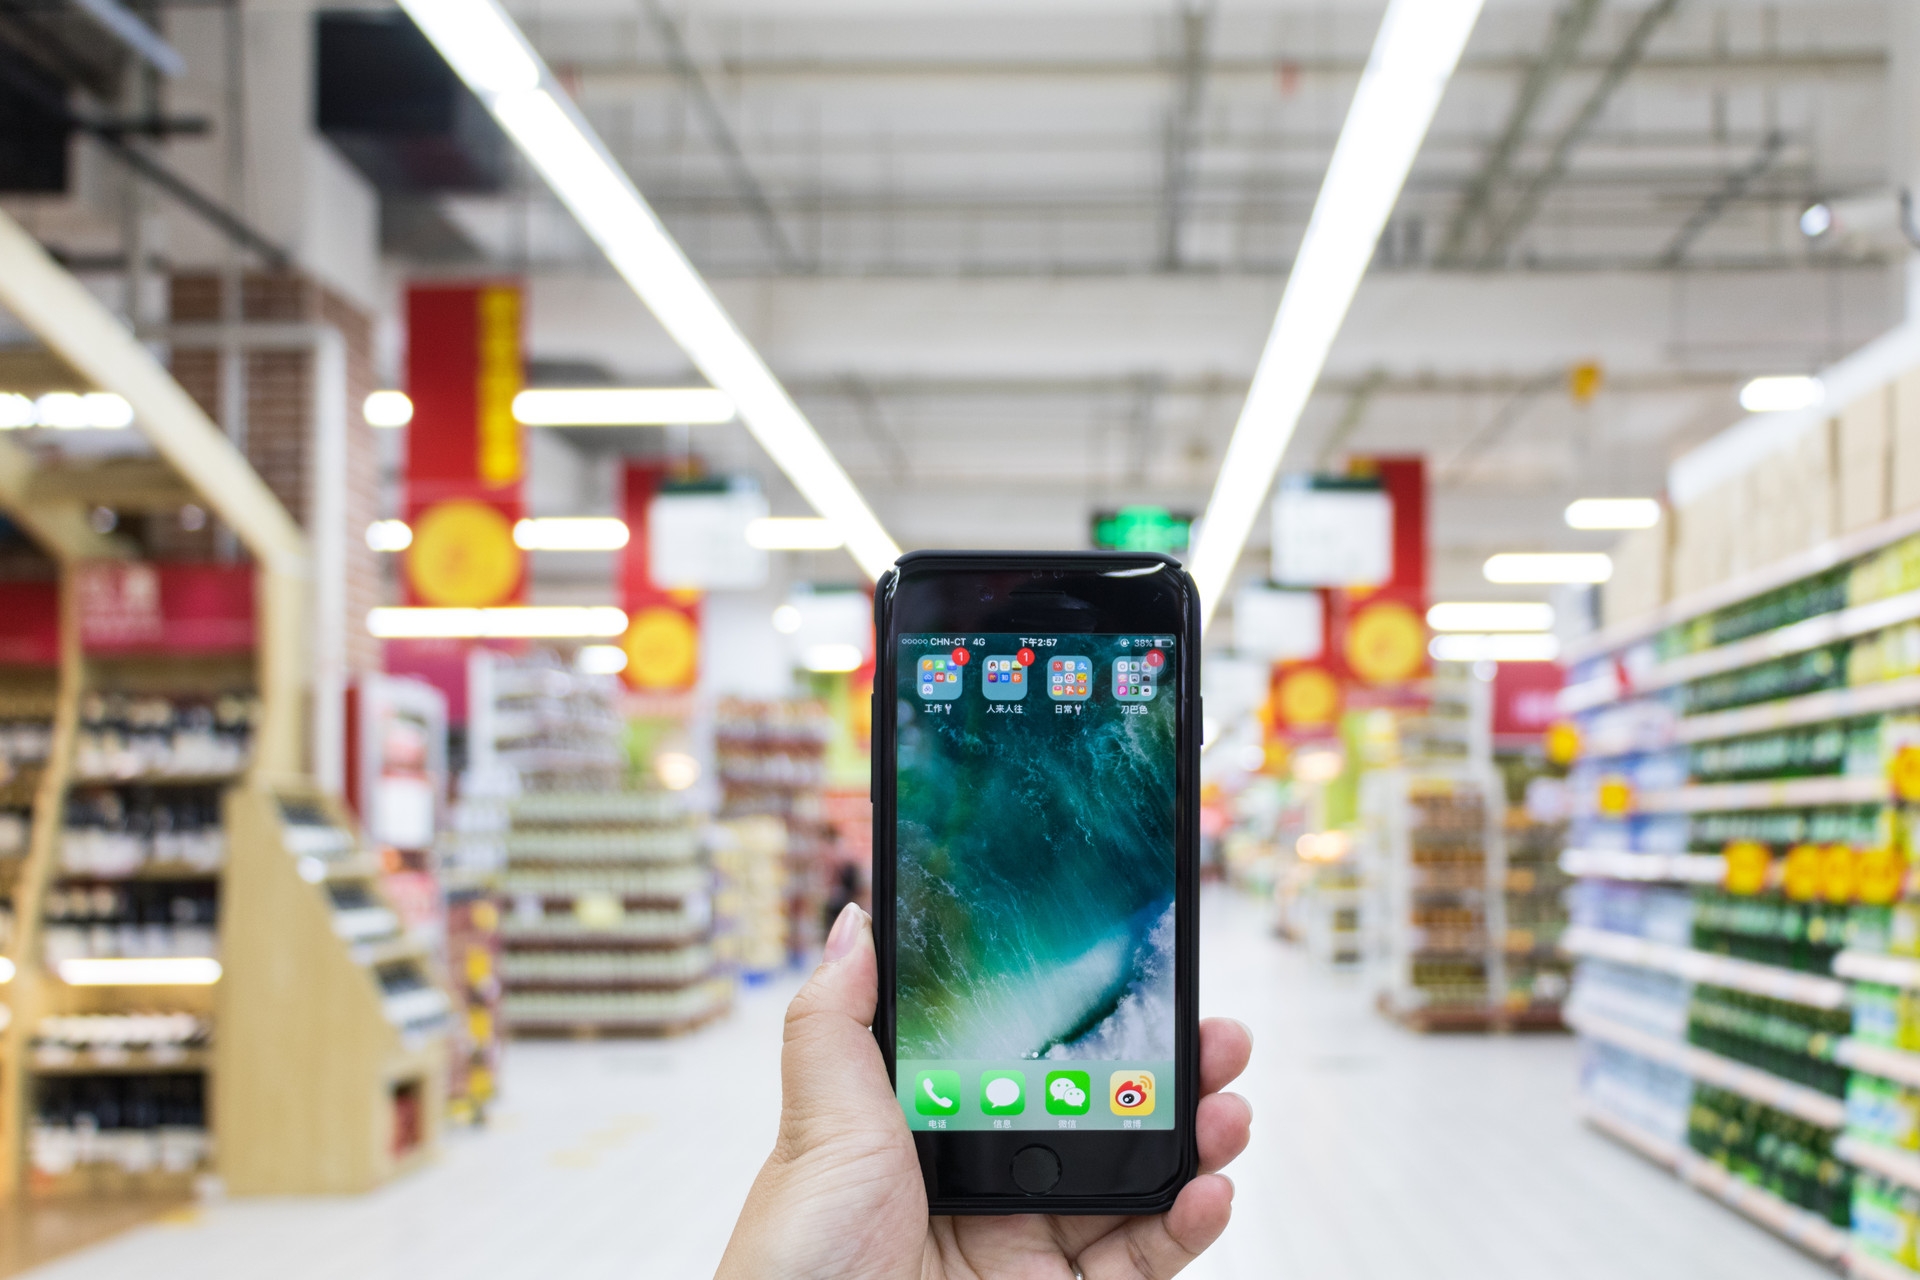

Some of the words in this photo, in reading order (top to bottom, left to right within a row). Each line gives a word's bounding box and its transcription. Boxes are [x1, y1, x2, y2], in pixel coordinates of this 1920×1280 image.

[930, 637, 967, 646] CHN-CT
[972, 637, 986, 646] 4G
[1019, 638, 1057, 647] 下午2:57
[1134, 639, 1153, 648] 38%
[958, 652, 964, 662] 1
[1023, 652, 1029, 662] 1
[1152, 653, 1158, 663] 1
[924, 704, 943, 714] 工作
[986, 704, 1023, 714] 人来人往
[1055, 704, 1073, 715] 日常
[1120, 704, 1148, 715] 刀巴色
[928, 1119, 947, 1129] 电话
[993, 1119, 1012, 1129] 信息
[1058, 1119, 1077, 1129] 微信
[1123, 1119, 1142, 1129] 微博
